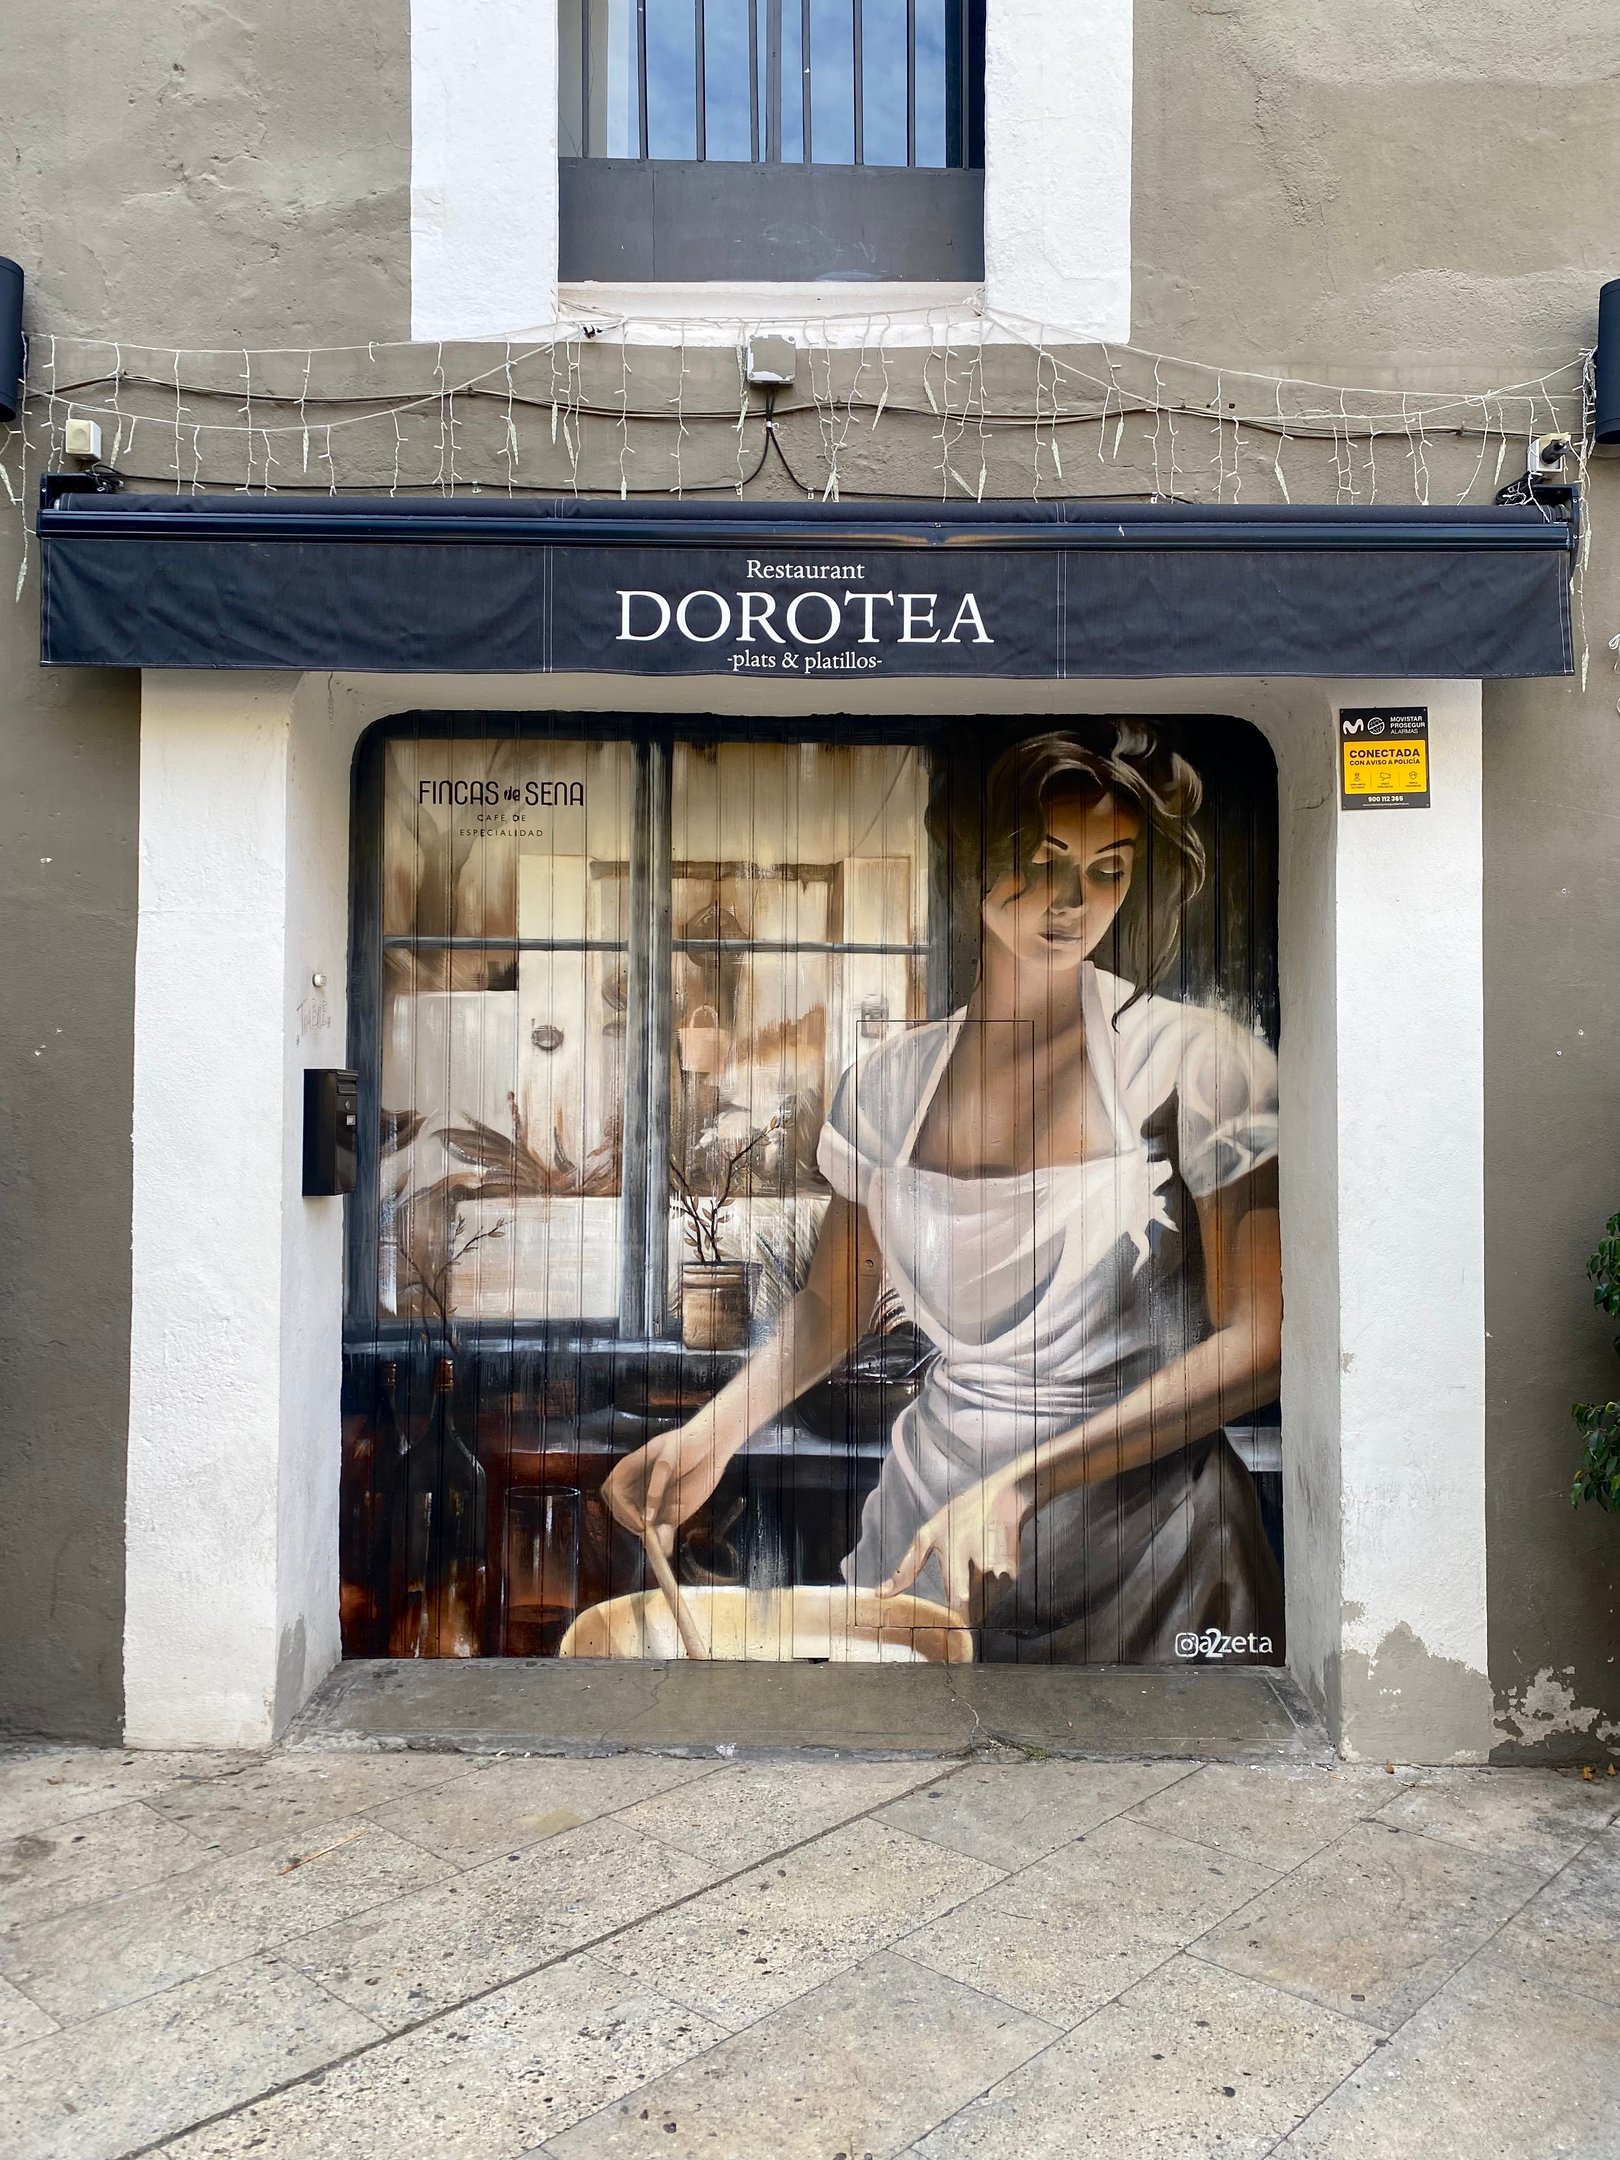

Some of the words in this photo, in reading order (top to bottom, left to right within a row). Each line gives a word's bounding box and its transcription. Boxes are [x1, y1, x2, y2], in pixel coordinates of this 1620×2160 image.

[746, 559, 865, 580] Restaurant
[615, 590, 994, 645] DOROTEA
[727, 649, 776, 671] -plats
[781, 651, 799, 668] &
[804, 650, 883, 674] platillos-
[1349, 748, 1420, 759] CONECTADA
[1394, 757, 1421, 765] POLICÍA
[419, 780, 499, 806] FINCAS
[504, 785, 521, 801] de
[525, 781, 584, 807] SENA
[512, 814, 527, 823] DE
[459, 829, 544, 838] ESPECIALIDAD
